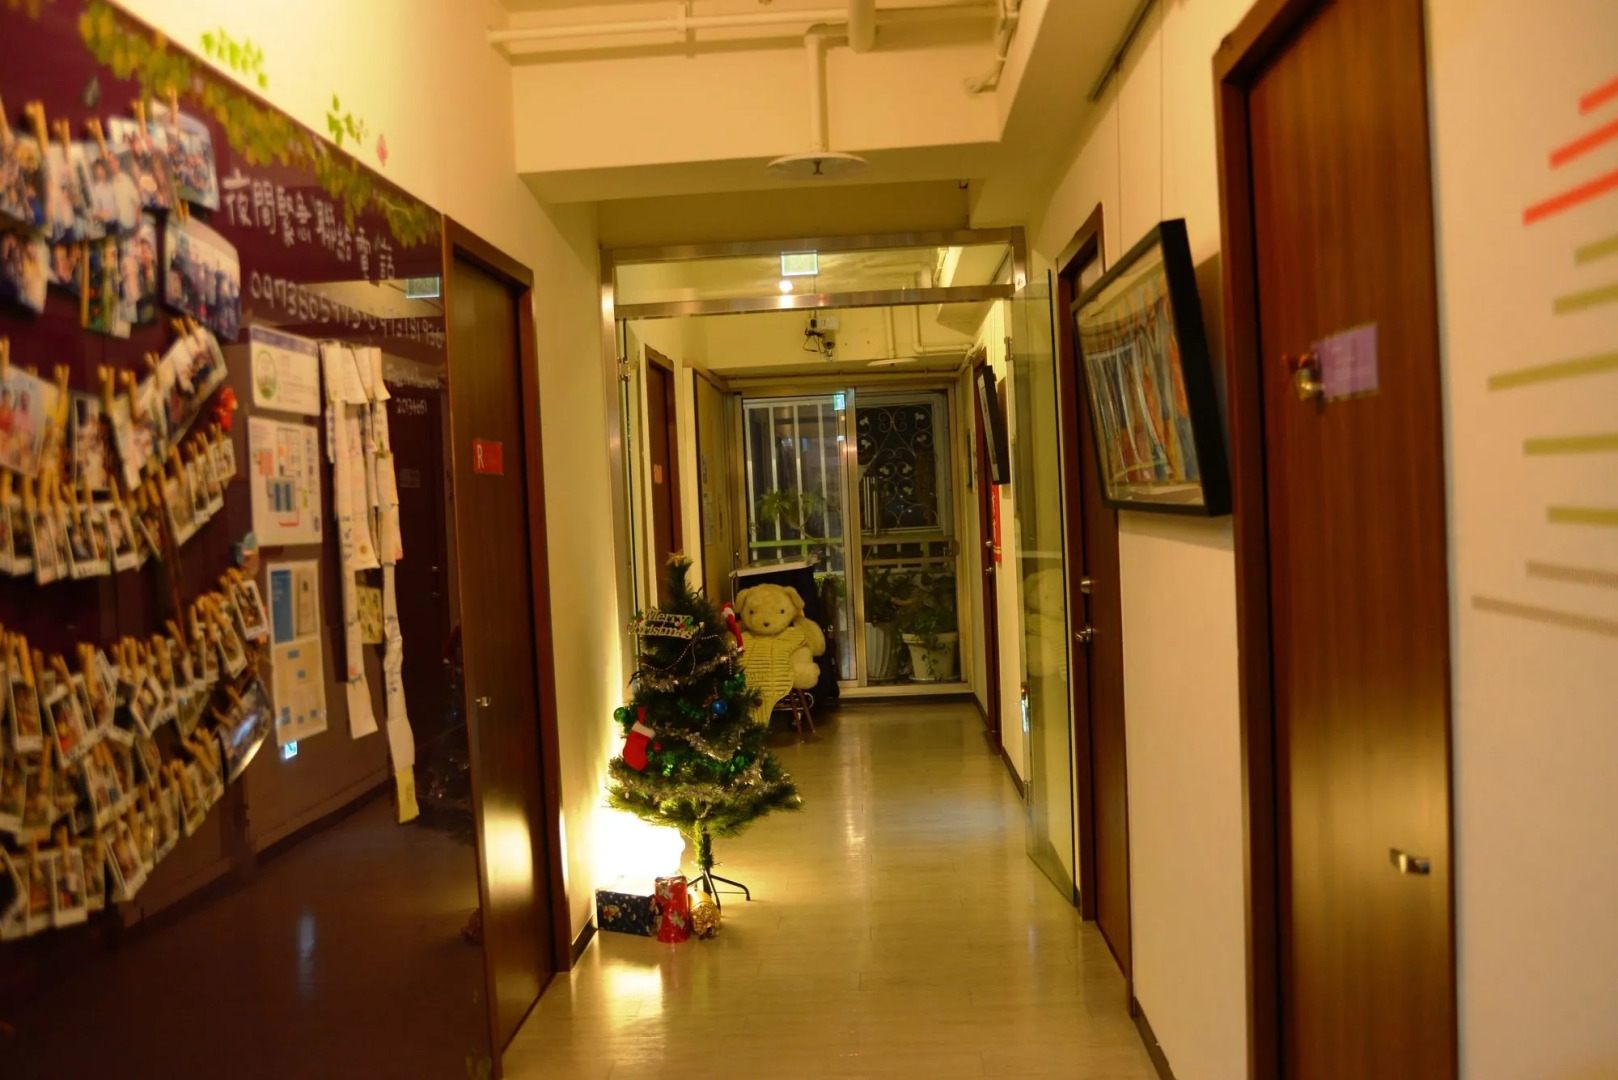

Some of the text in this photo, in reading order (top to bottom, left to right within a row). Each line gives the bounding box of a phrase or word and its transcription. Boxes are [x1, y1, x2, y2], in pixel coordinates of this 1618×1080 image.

[222, 168, 395, 280] 夜間緊急聯絡電話
[644, 610, 688, 627] Merry
[627, 621, 693, 639] Christmas
